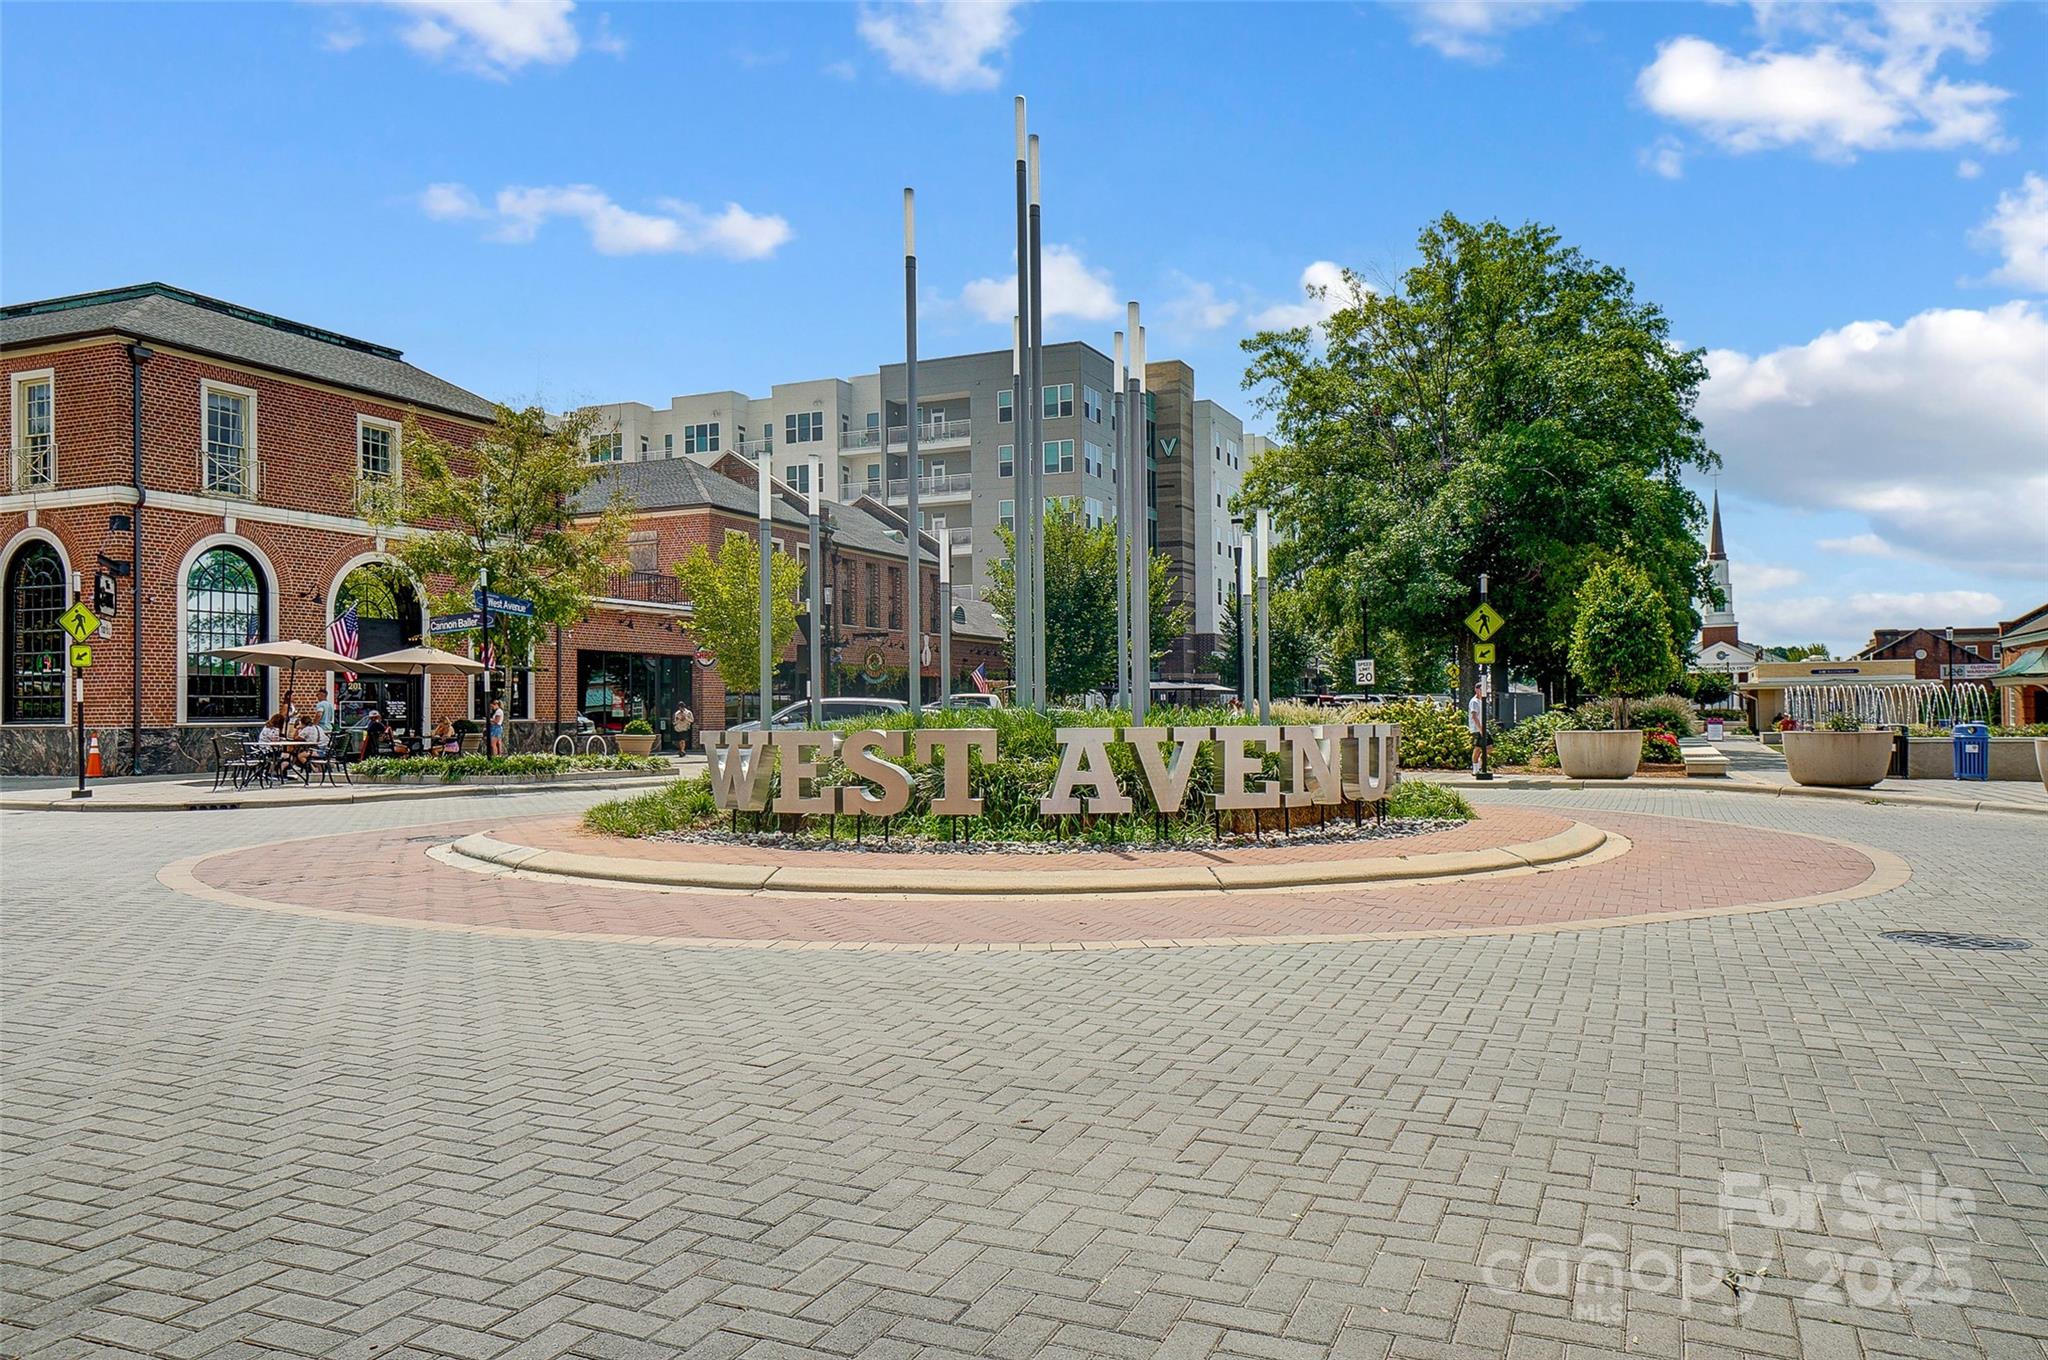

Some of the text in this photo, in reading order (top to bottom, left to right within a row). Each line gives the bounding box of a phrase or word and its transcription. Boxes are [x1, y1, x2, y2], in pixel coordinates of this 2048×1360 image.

[1159, 437, 1178, 457] V
[487, 597, 527, 613] West Avenue
[430, 617, 479, 631] Cannon Baller
[1358, 672, 1373, 682] 20
[1942, 665, 1963, 677] Lee
[347, 682, 362, 690] 201
[700, 723, 1401, 817] WEST AVENU
